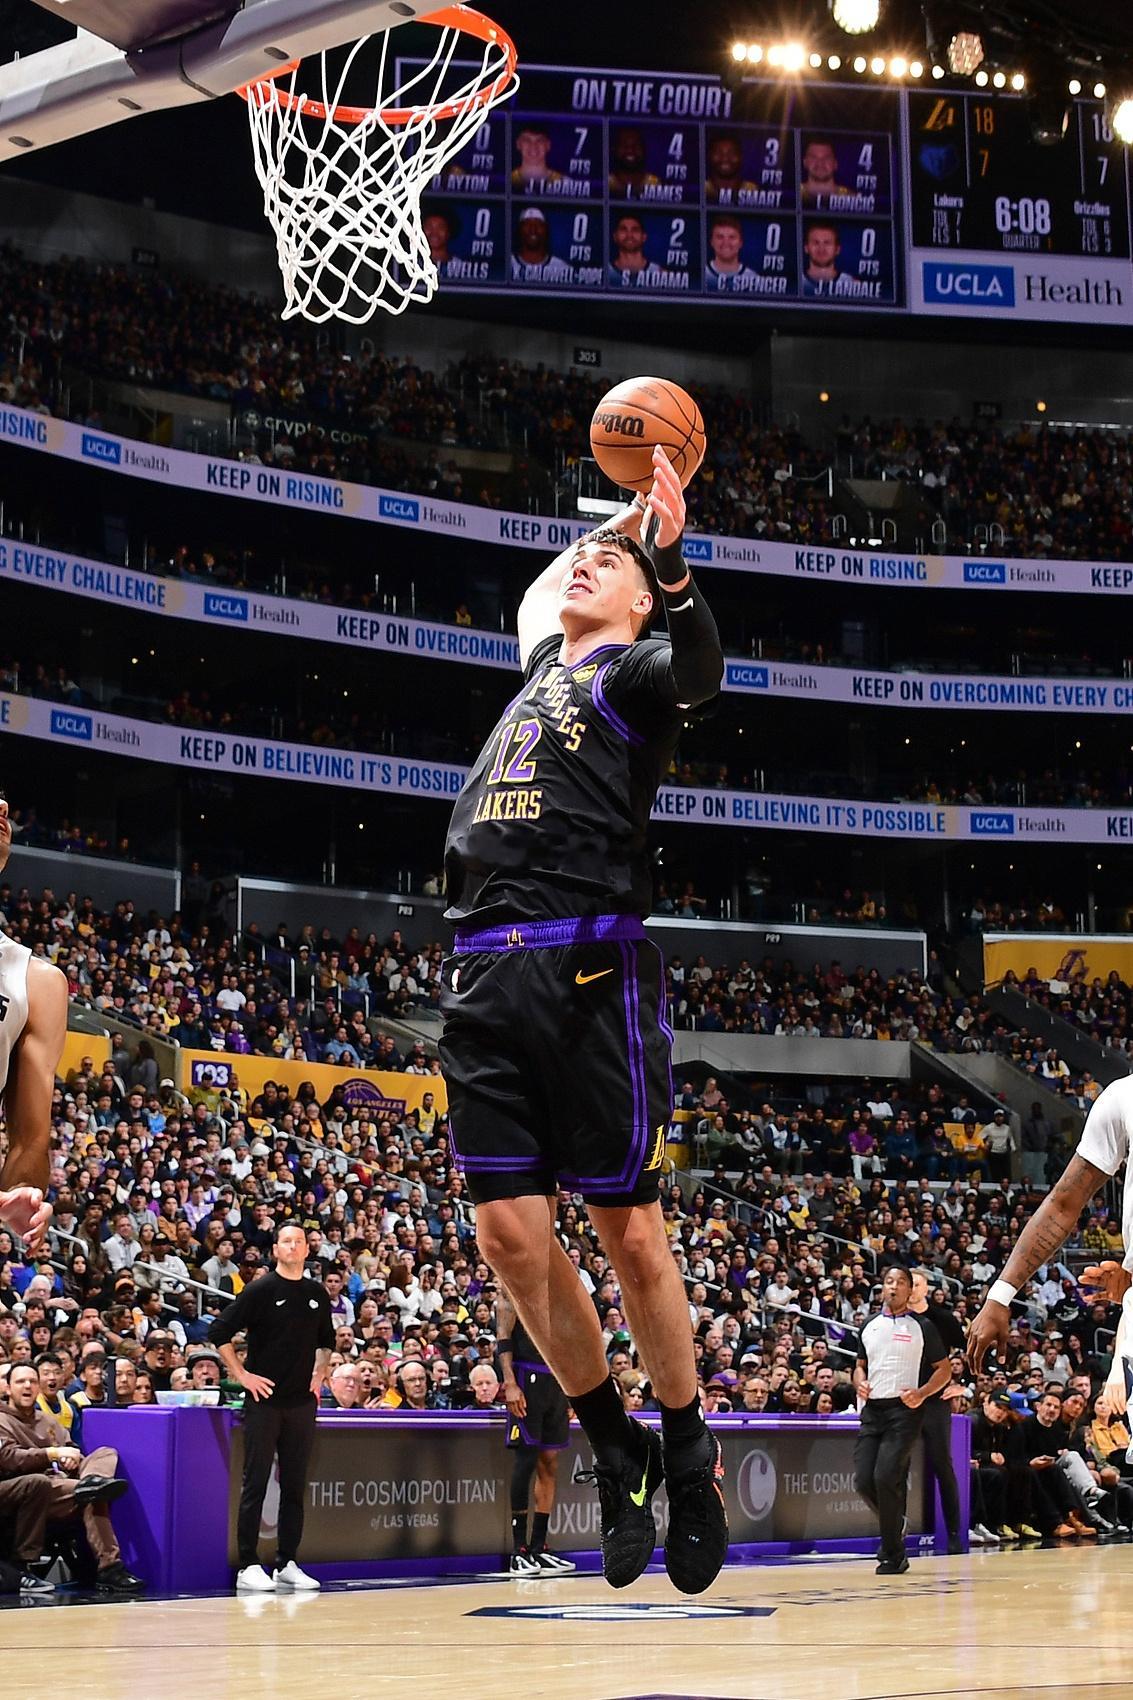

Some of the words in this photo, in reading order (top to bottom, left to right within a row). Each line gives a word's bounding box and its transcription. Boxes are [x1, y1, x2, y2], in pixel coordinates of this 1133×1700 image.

[572, 79, 606, 111] ON
[612, 81, 652, 114] THE
[975, 108, 994, 135] 18
[475, 122, 491, 151] 0
[574, 127, 588, 158] 7
[668, 133, 684, 161] 4
[472, 154, 494, 170] PTS
[765, 138, 780, 166] 3
[858, 143, 873, 172] 4
[980, 150, 990, 177] 7
[569, 159, 591, 175] PTS
[666, 164, 687, 181] PTS
[762, 170, 783, 186] PTS
[1097, 157, 1108, 185] 7
[448, 174, 490, 192] AYTON
[640, 185, 683, 203] JAMES
[856, 175, 877, 190] PTS
[738, 189, 782, 209] SMART
[475, 208, 491, 238] 0
[573, 213, 588, 243] 0
[995, 196, 1051, 235] 6:08
[670, 218, 685, 248] 2
[766, 223, 781, 252] 0
[861, 228, 876, 257] 0
[471, 241, 494, 257] PTS
[570, 245, 591, 262] PTS
[667, 250, 688, 267] PTS
[447, 261, 489, 280] WELLS
[763, 255, 784, 272] PTS
[858, 260, 879, 276] PTS
[637, 271, 689, 289] ALDAMA
[733, 275, 787, 294] SPENCER
[828, 281, 881, 299] LANDALE
[935, 272, 1003, 298] UCLA
[1025, 275, 1123, 307] Health
[0, 411, 47, 443] ISING
[86, 441, 117, 459] UCLA
[124, 449, 170, 473] Health
[207, 463, 251, 490] KEEP
[257, 472, 280, 497] ON
[286, 477, 343, 508] RISING
[384, 501, 415, 517] UCLA
[423, 506, 466, 528] Health
[500, 517, 541, 542] KEEP
[548, 525, 570, 545] ON
[716, 545, 760, 562] Health
[795, 551, 835, 574] KEEP
[841, 556, 863, 576] ON
[870, 558, 927, 580] RISING
[13, 549, 68, 583] EVERY
[72, 563, 167, 608] CHALLENGE
[968, 566, 1001, 579] UCLA
[1010, 567, 1055, 583] Health
[1091, 568, 1133, 588] KEEP
[209, 600, 243, 616] UCLA
[252, 604, 300, 626] Health
[337, 614, 380, 641] KEEP
[386, 622, 409, 647] ON
[415, 627, 520, 664] OVERCOMING
[731, 670, 764, 684] UCLA
[772, 672, 817, 689] Health
[852, 676, 894, 700] KEEP
[900, 681, 924, 702] ON
[930, 682, 1046, 706] OVERCOMING
[1053, 685, 1107, 706] EVERY
[55, 716, 88, 735] UCLA
[96, 723, 141, 747] Health
[180, 736, 226, 763] KEEP
[232, 742, 257, 768] ON
[263, 747, 354, 780] BELIEVING
[361, 760, 391, 785] IT'S
[399, 765, 467, 794] POSSIB
[487, 718, 543, 786] 12
[472, 789, 543, 824] LAKERS
[653, 793, 696, 815] KEEP
[702, 796, 726, 818] ON
[732, 798, 820, 826] BELIEVING
[826, 805, 856, 828] IT'S
[862, 808, 945, 832] POSSIBLE
[976, 818, 1009, 830] UCLA
[1018, 818, 1065, 832] Health
[1106, 816, 1133, 836] KE
[195, 1063, 229, 1085] 103
[366, 1099, 404, 1109] ANGELES
[309, 1481, 345, 1507] THE
[352, 1479, 496, 1507] COSMOPOLITAN
[784, 1473, 808, 1494] THE
[383, 1514, 404, 1529] LAS
[407, 1513, 439, 1528] VEGAS
